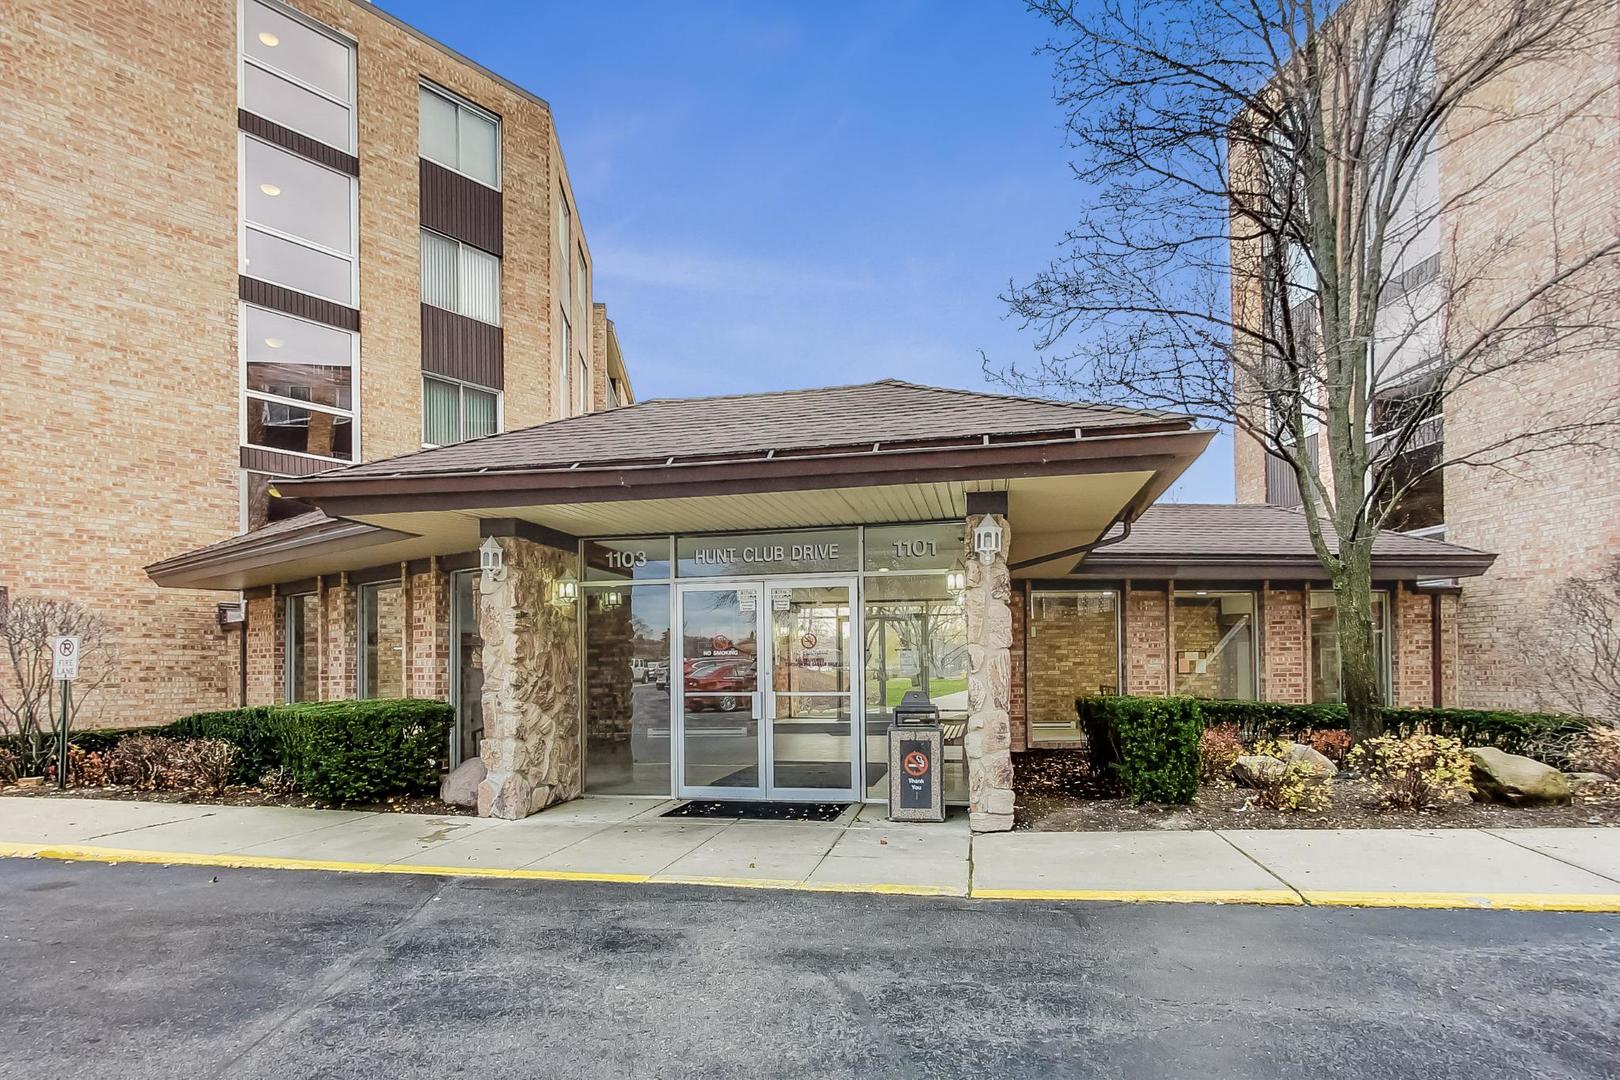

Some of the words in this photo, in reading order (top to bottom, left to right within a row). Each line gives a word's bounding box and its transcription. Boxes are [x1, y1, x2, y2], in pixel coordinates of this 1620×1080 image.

[695, 548, 736, 565] HUNT
[742, 546, 785, 563] CLUB
[790, 543, 839, 561] DRIVE
[892, 537, 937, 557] 1101
[605, 551, 647, 569] 1103
